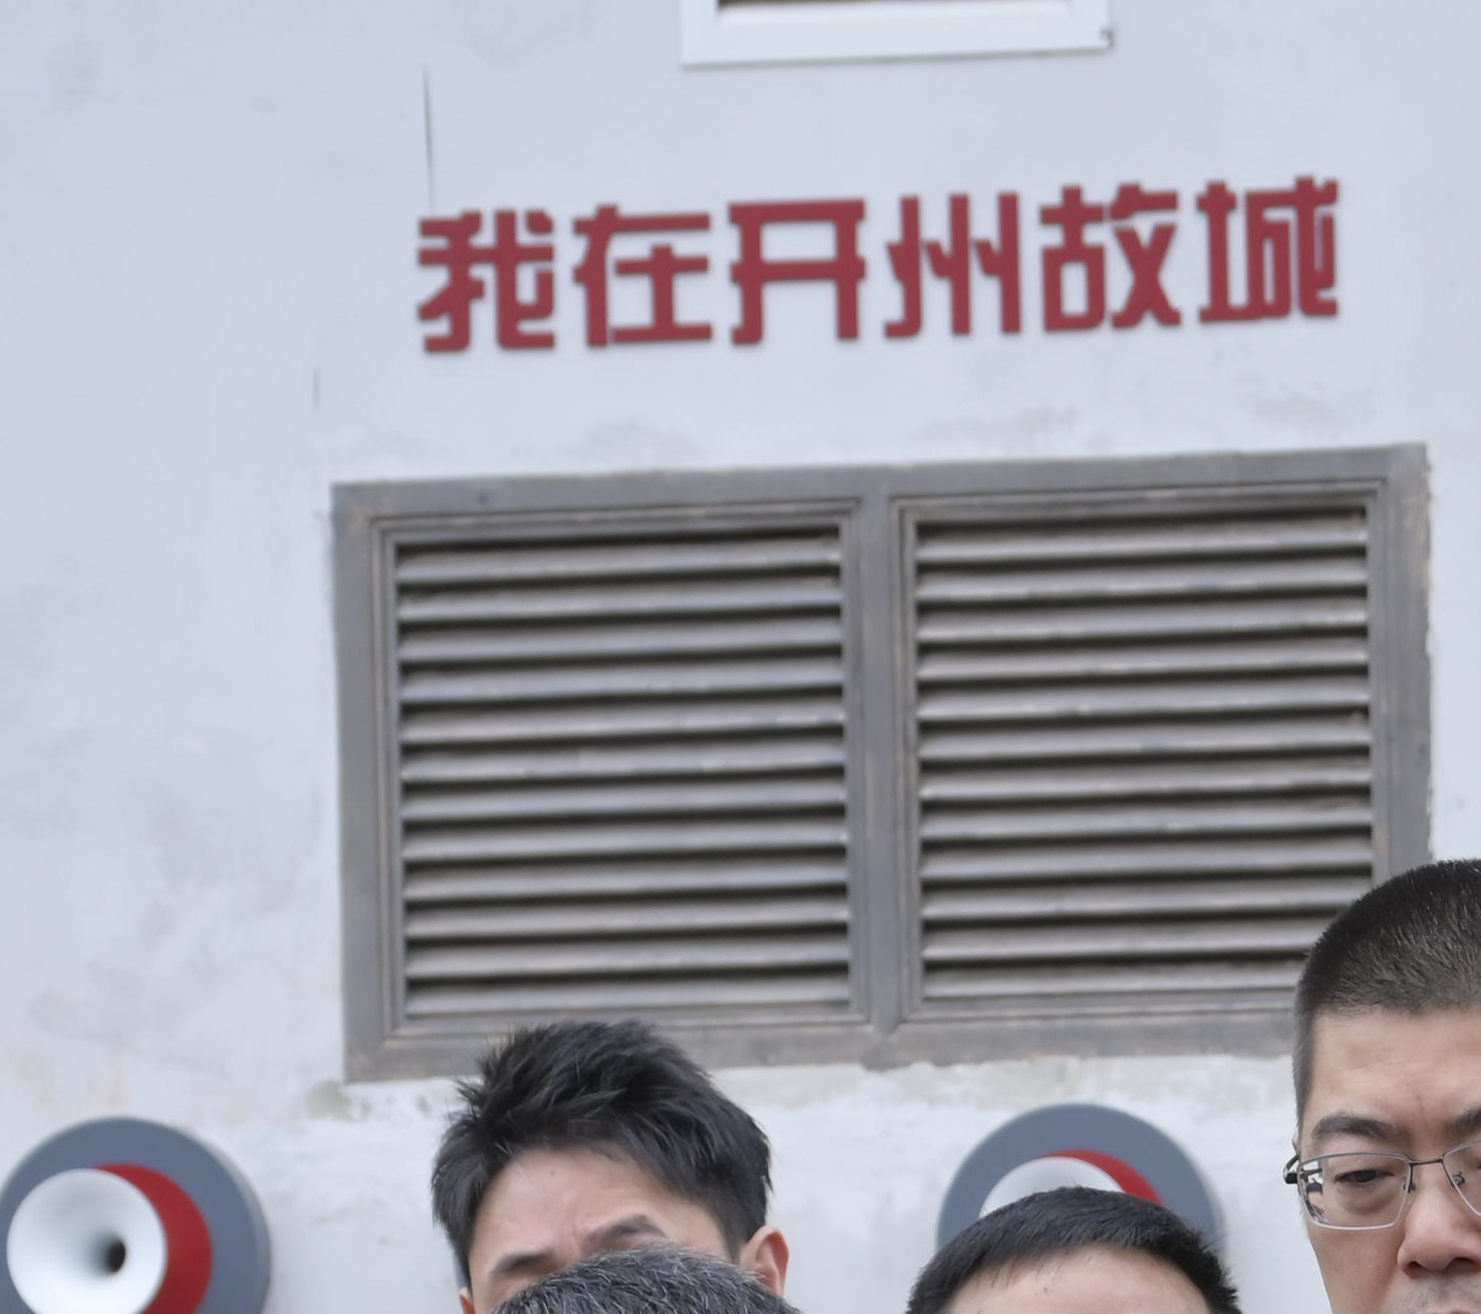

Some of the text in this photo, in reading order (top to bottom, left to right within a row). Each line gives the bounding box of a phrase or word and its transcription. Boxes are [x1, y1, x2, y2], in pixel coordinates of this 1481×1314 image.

[419, 178, 1338, 351] 我在开州故城
